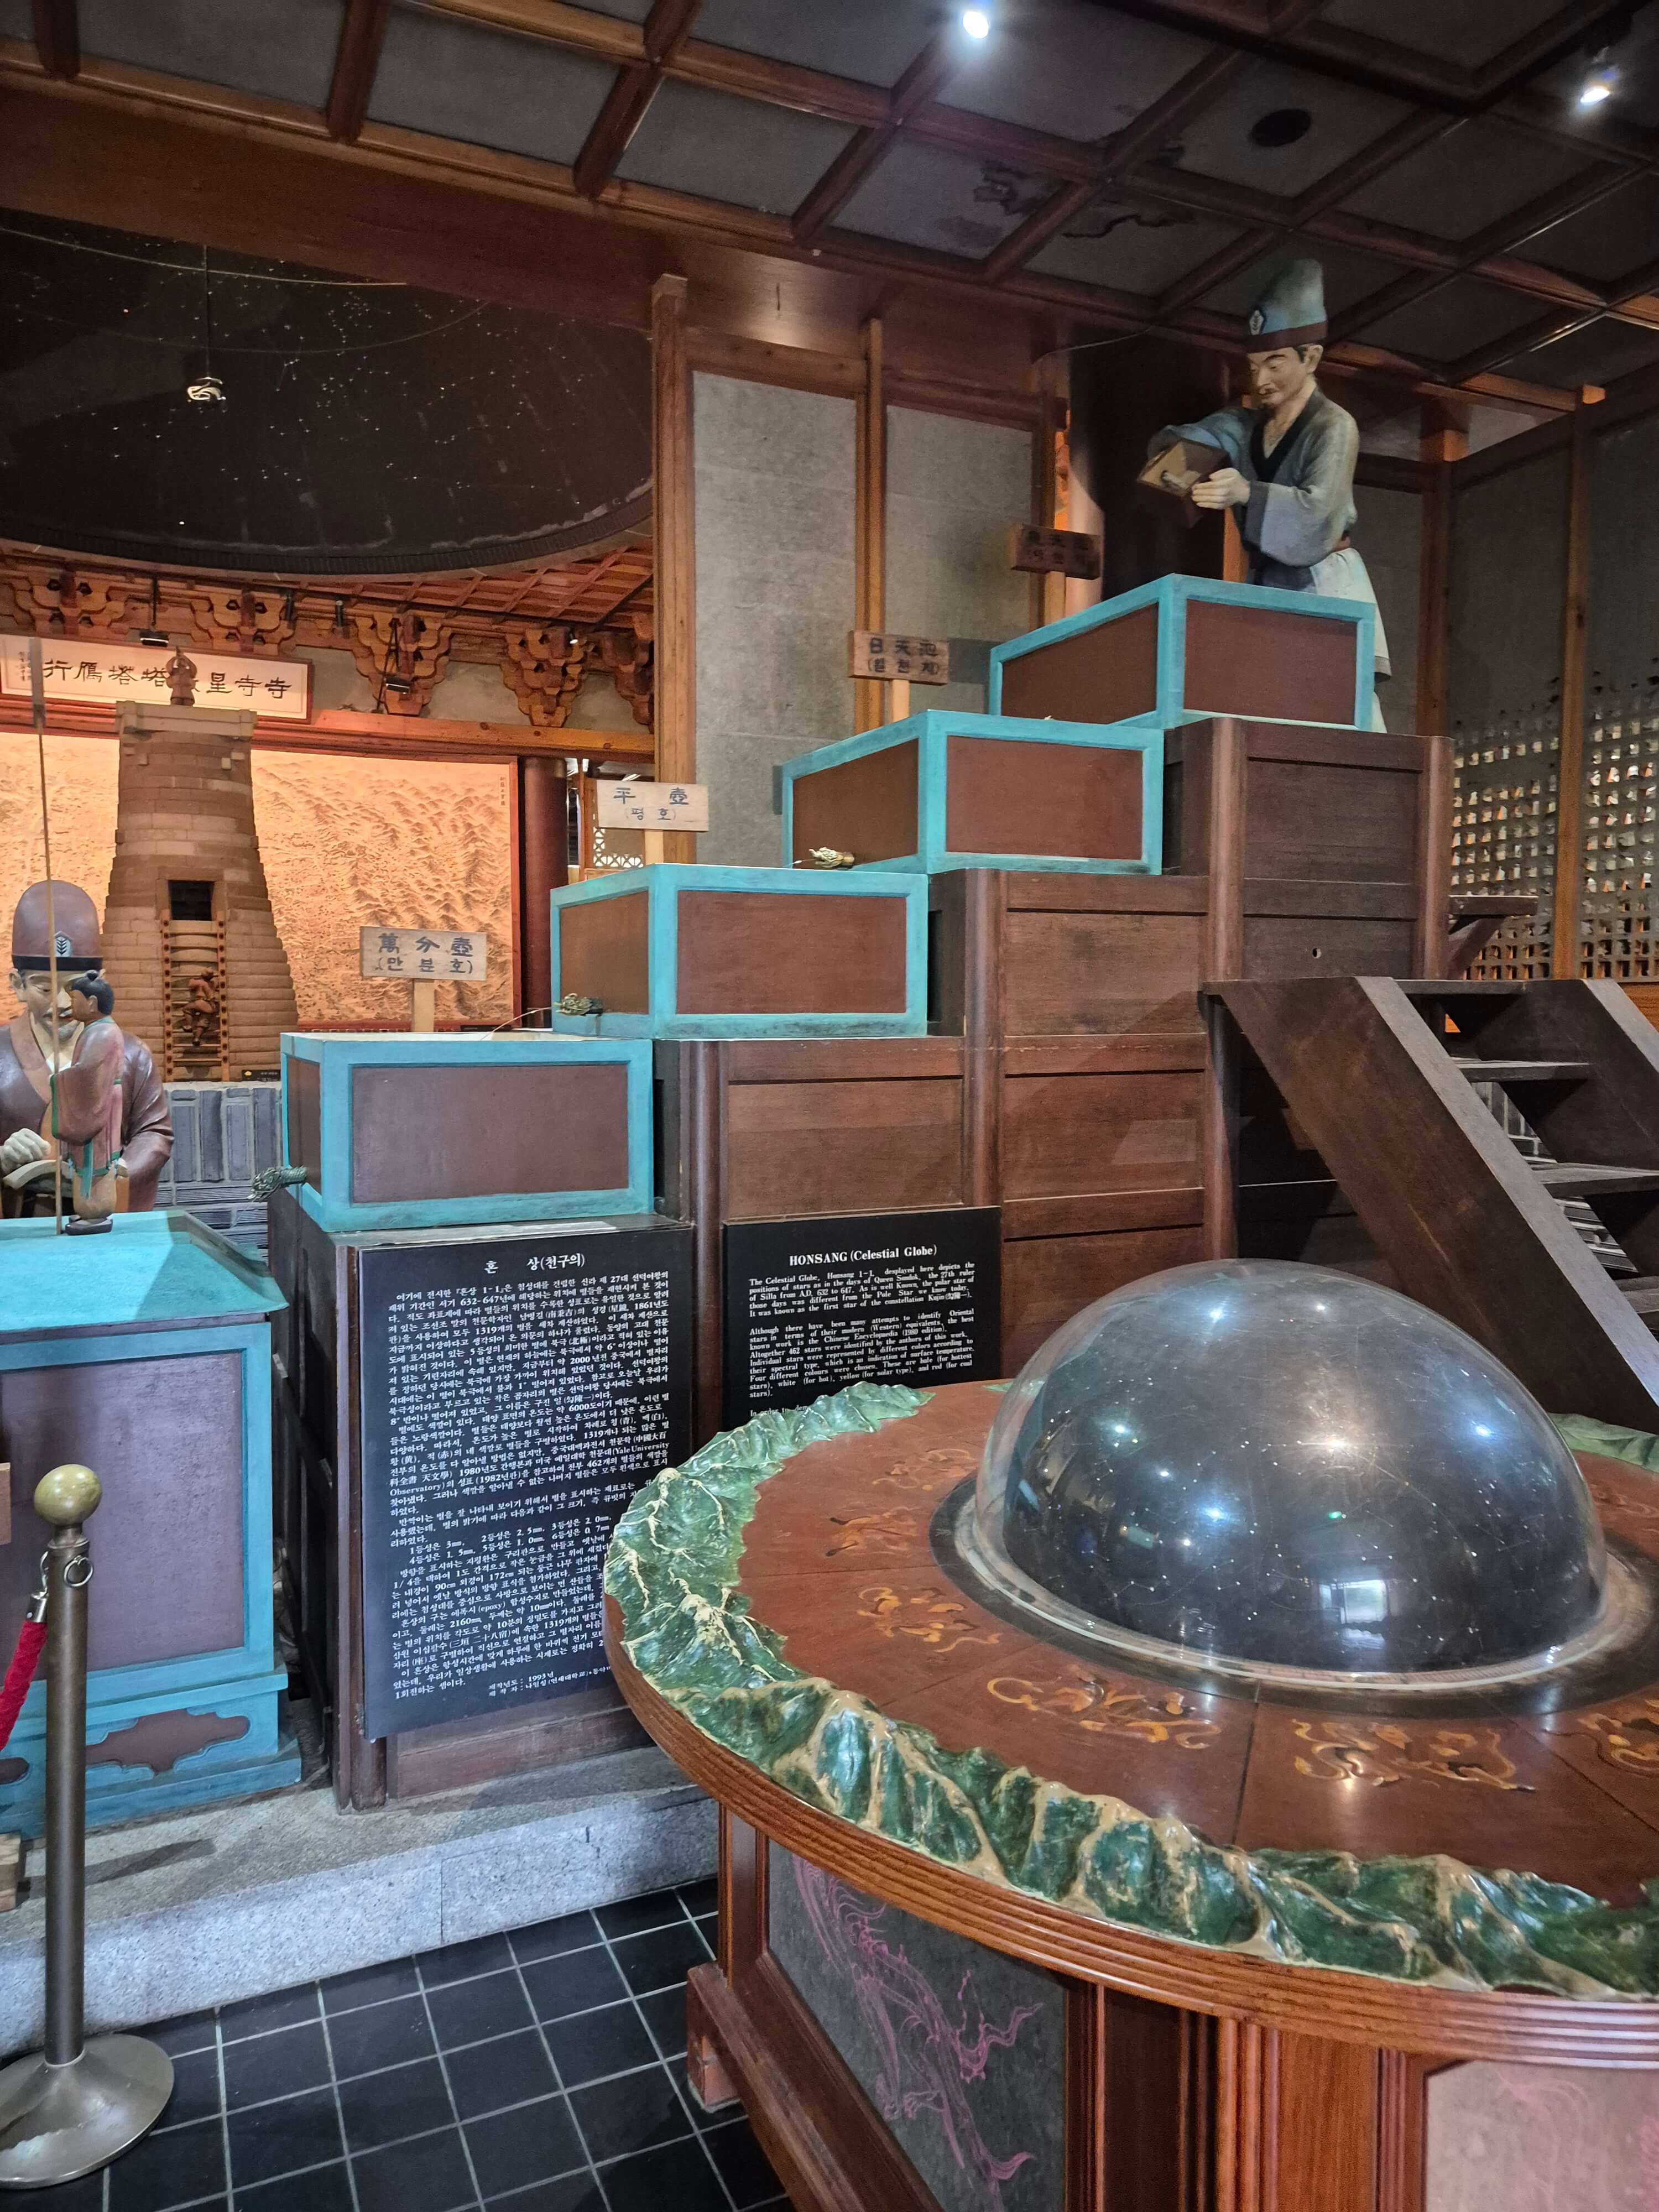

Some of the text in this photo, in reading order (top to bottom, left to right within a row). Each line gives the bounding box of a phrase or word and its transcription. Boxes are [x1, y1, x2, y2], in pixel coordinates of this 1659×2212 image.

[790, 1244, 937, 1266] HONSANG (Celestial Globe)
[765, 1275, 796, 1285] Celestial
[965, 1261, 975, 1270] the
[749, 1326, 779, 1335] Although
[917, 1311, 941, 1319] identify
[949, 1308, 974, 1318] Oriental
[902, 1328, 918, 1337] (1980
[921, 1326, 947, 1335] edition).
[750, 1349, 786, 1359] Altogether
[844, 1340, 873, 1349] identified
[769, 1371, 799, 1380] different
[839, 1373, 860, 1381] yellow
[749, 1389, 773, 1398] stars).
